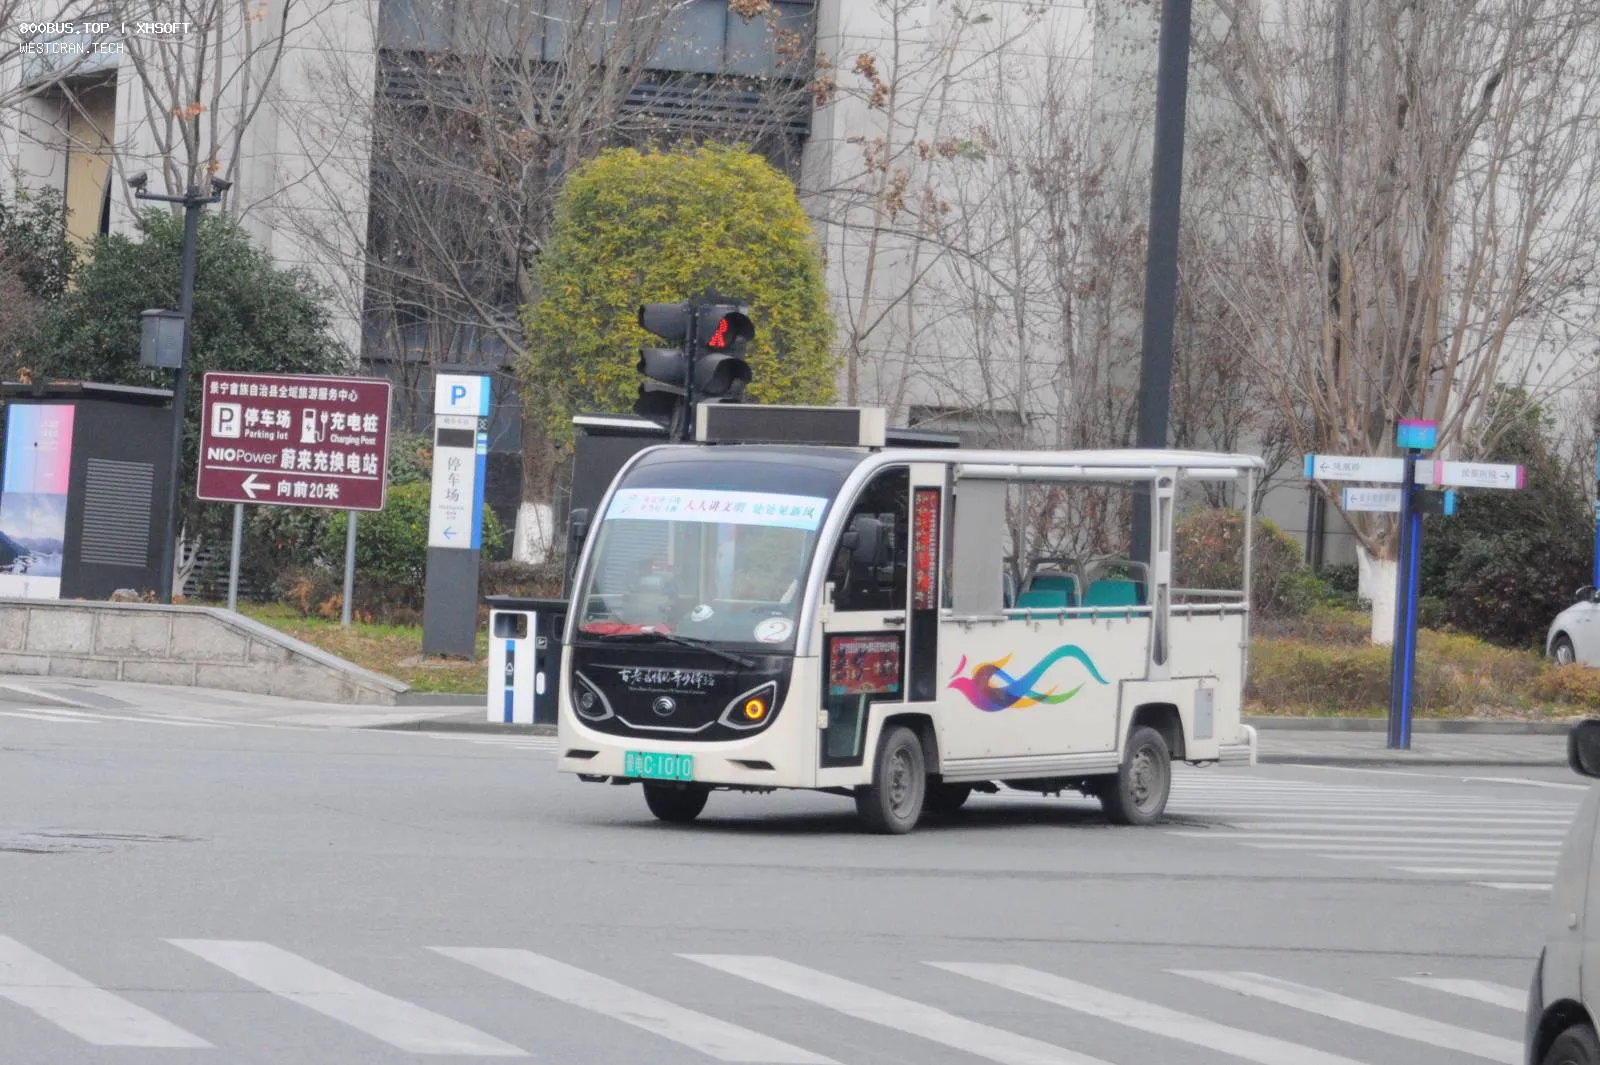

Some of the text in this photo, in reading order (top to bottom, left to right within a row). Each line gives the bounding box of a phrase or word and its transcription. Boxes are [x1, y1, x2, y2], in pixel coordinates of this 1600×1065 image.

[450, 385, 467, 406] P
[218, 407, 235, 433] P
[244, 407, 292, 429] 停车场
[330, 411, 379, 433] 充电桩
[244, 428, 275, 441] Parking
[330, 433, 377, 446] Charging Post
[207, 447, 378, 475] NIOPower 蔚来充换电站
[445, 455, 462, 502] 停车场
[277, 480, 340, 500] 向前20米
[763, 621, 787, 641] 2
